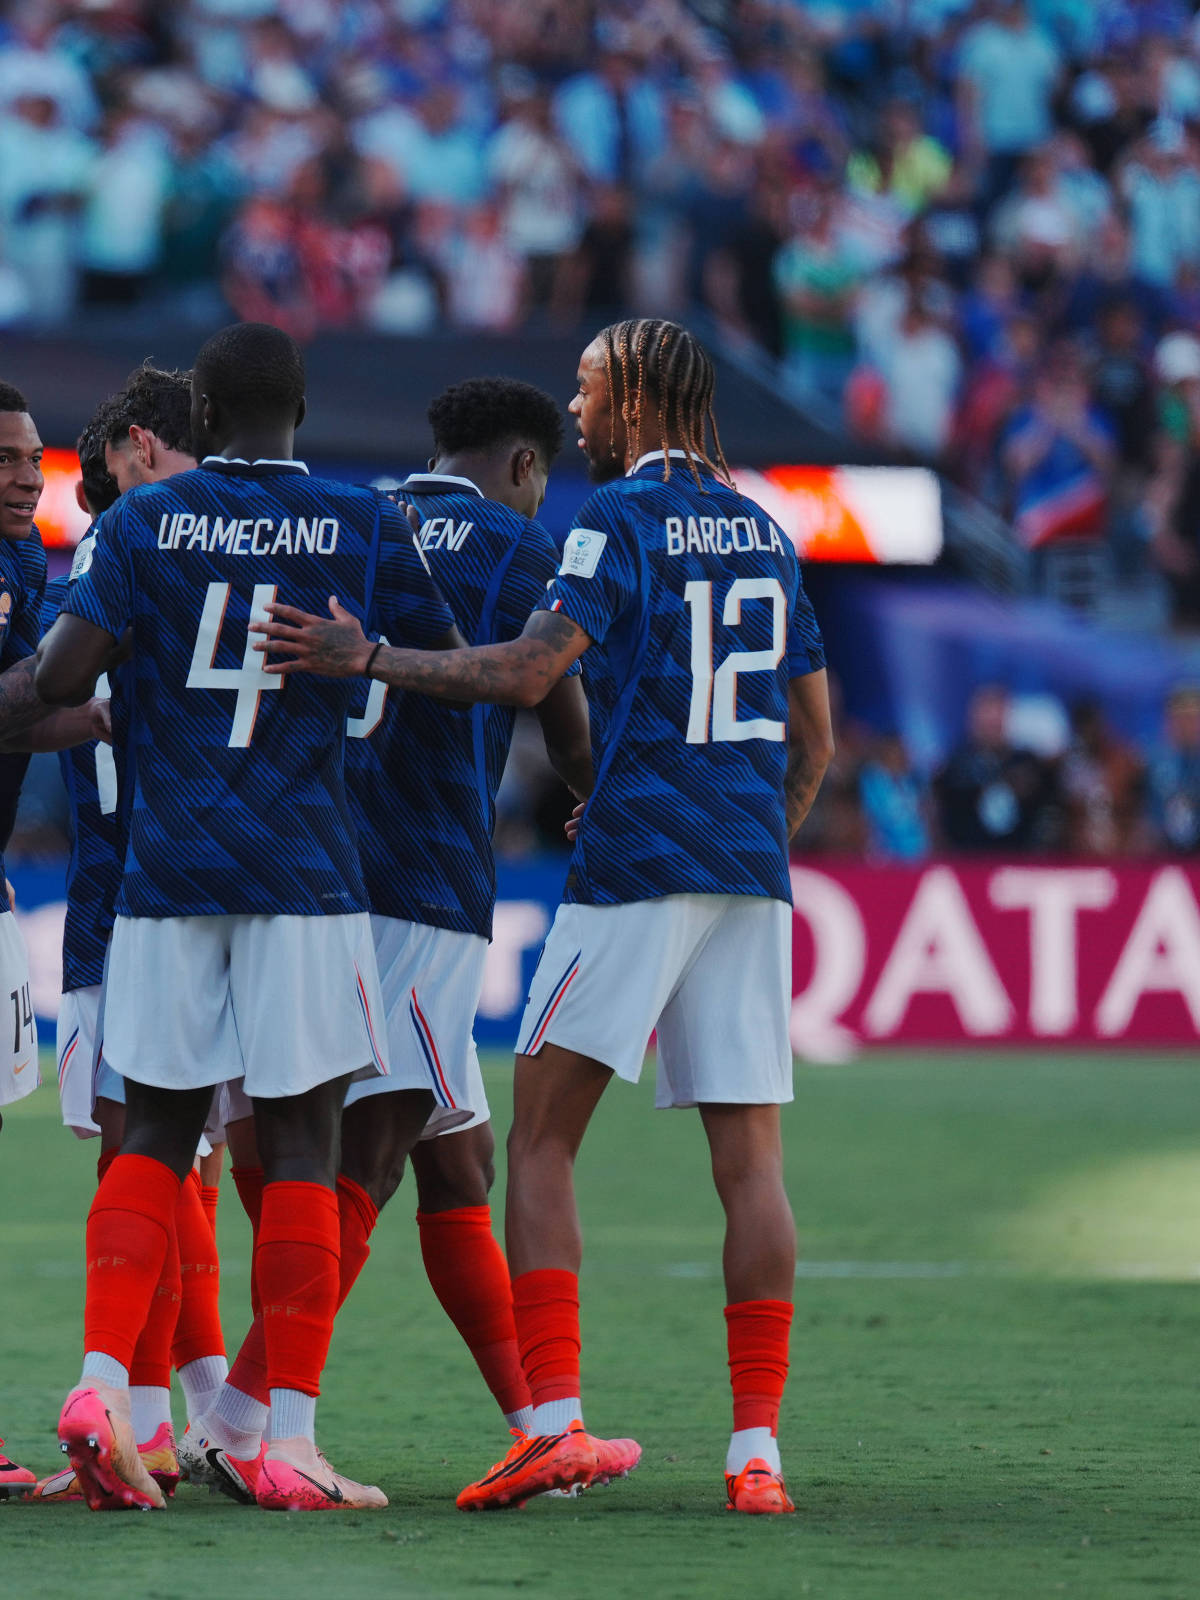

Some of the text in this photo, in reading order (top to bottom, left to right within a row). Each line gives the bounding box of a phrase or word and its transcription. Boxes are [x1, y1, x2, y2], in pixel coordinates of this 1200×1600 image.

[157, 513, 340, 556] UPAMECANO
[665, 515, 785, 556] BARCOLA
[185, 582, 284, 748] 4
[683, 577, 787, 744] 12
[10, 980, 35, 1055] 14
